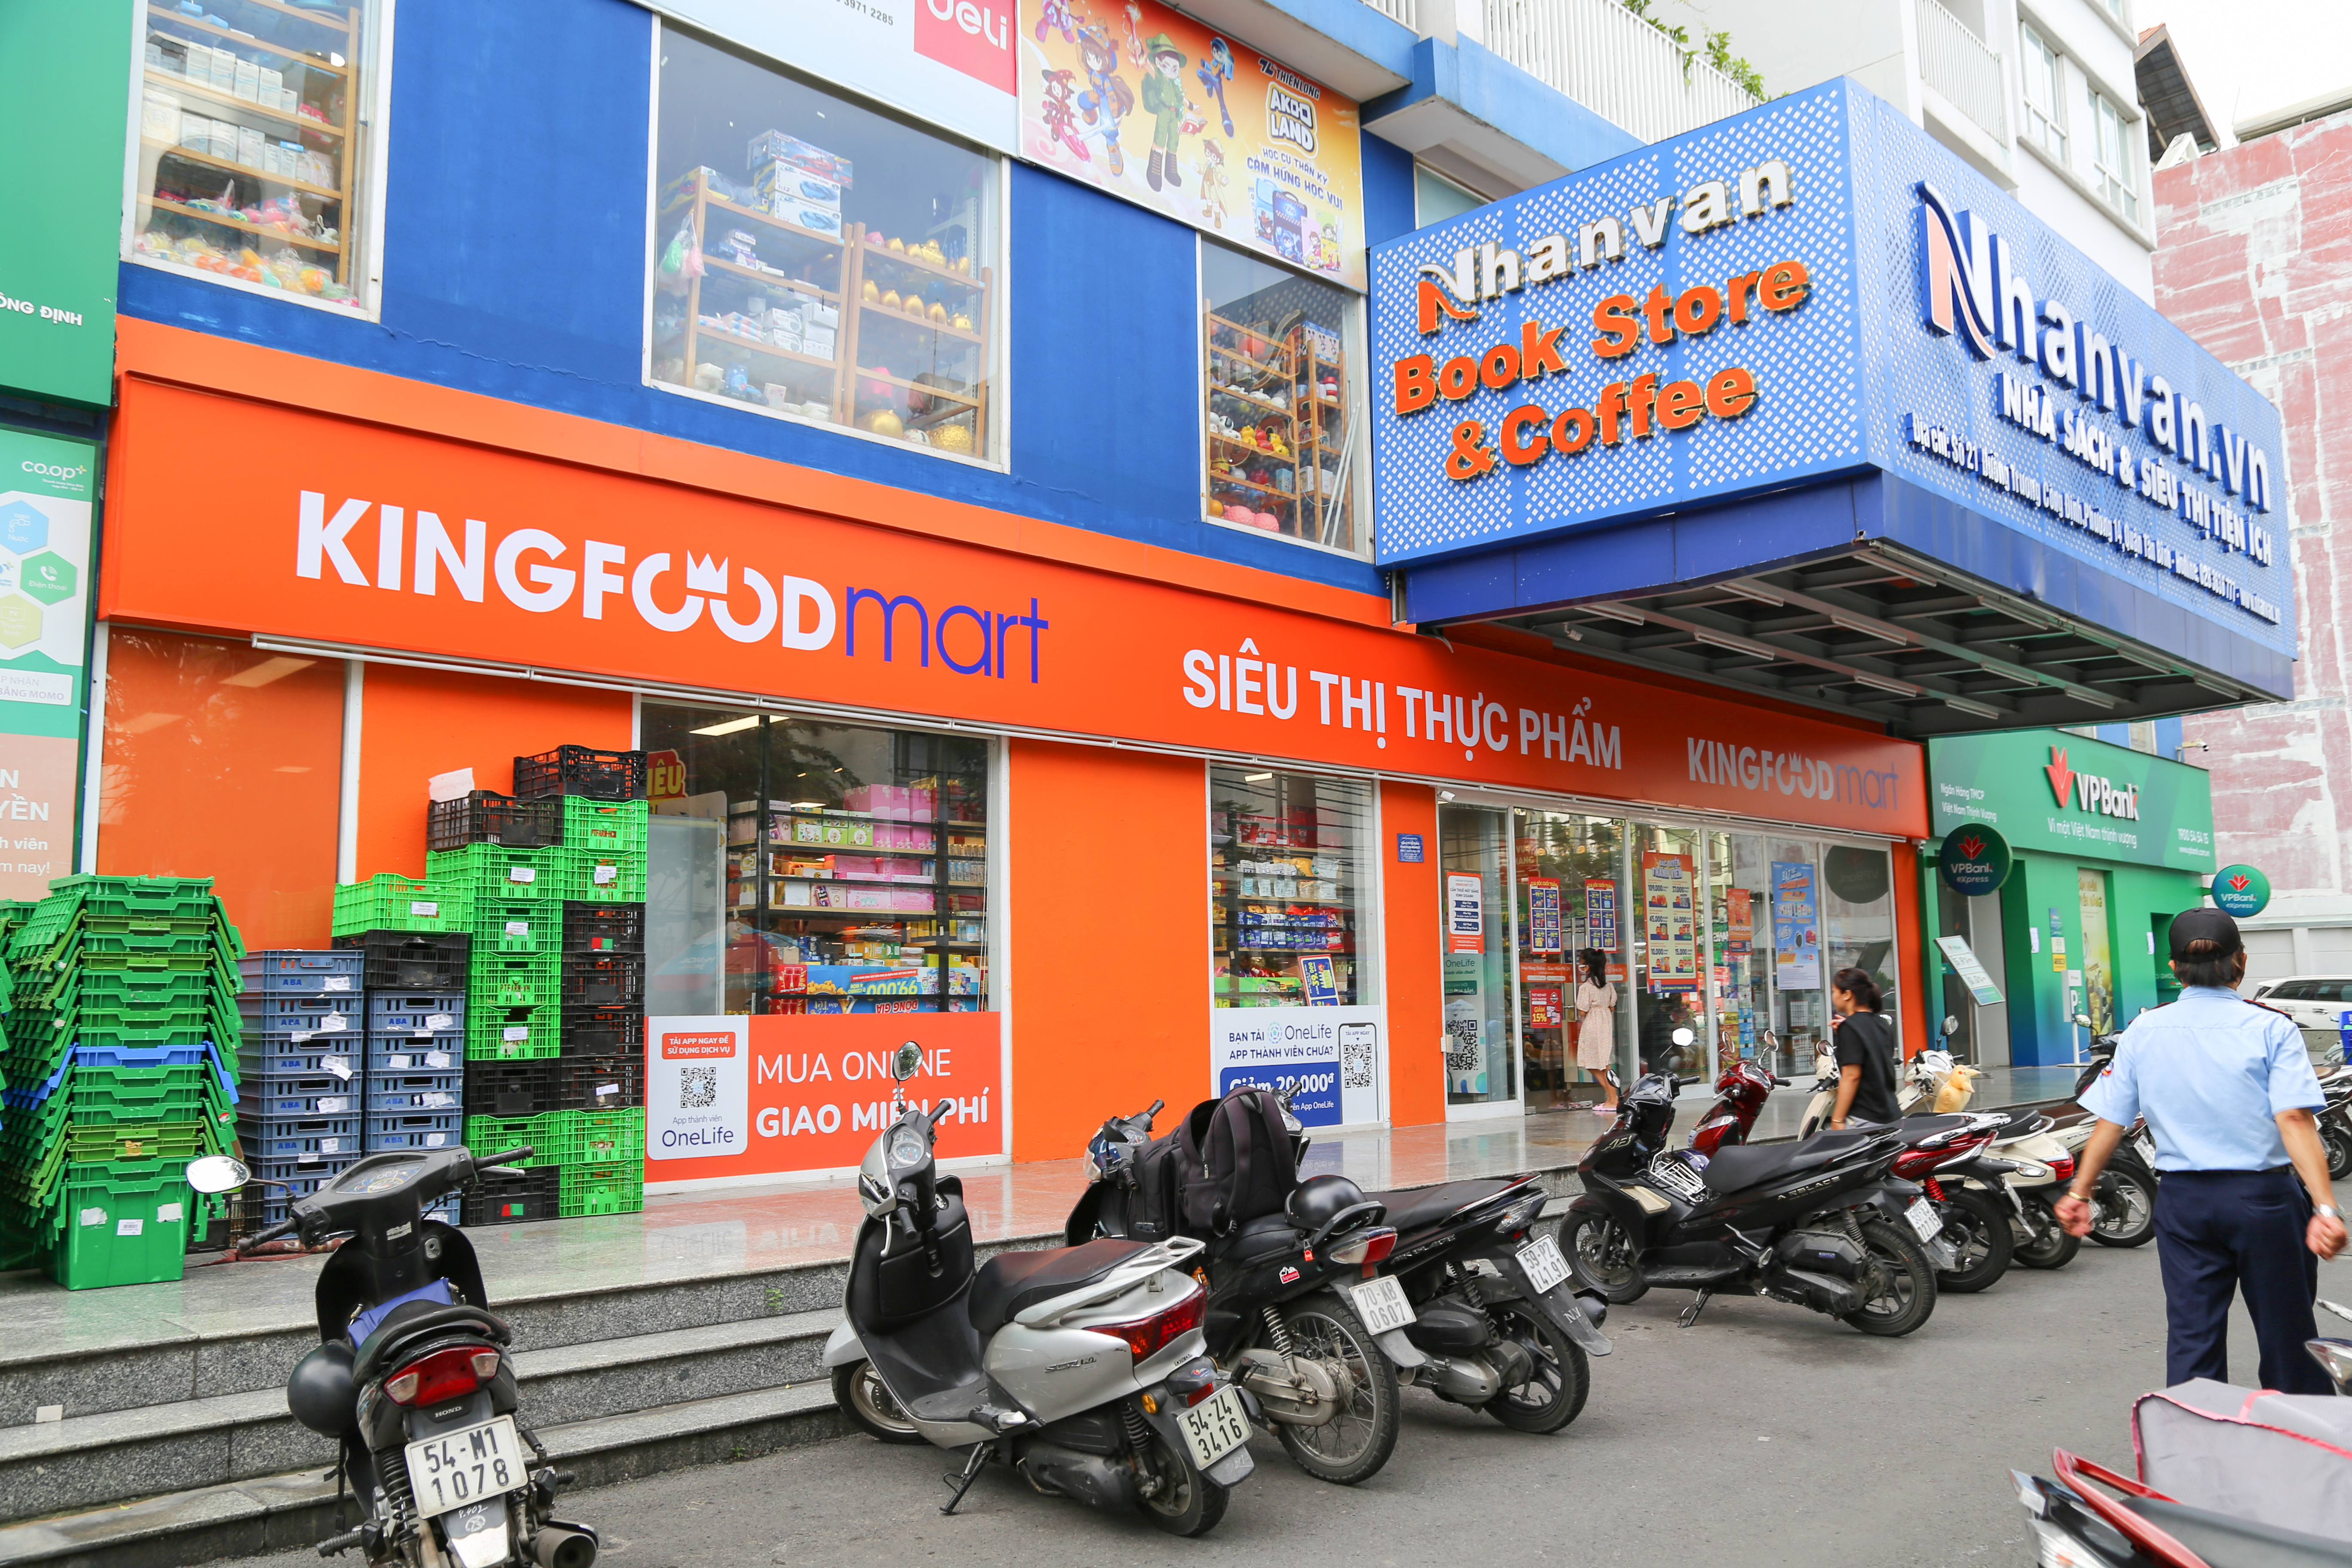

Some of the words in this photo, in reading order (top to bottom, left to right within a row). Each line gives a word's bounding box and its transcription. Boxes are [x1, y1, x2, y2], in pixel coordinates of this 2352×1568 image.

[870, 8, 893, 26] 2285
[1271, 113, 1314, 152] LAND
[1305, 180, 1324, 199] HỌC
[1326, 191, 1343, 211] VUI
[1417, 159, 1792, 335] Nhanvan
[40, 305, 83, 327] ĐỊNH
[1394, 319, 1570, 416] Book
[1591, 259, 1811, 358] Store
[2000, 372, 2057, 442] NHÀ
[2060, 408, 2114, 476] SÁCH
[2138, 457, 2179, 510] SIÊU
[2181, 481, 2211, 540] THỊ
[29, 580, 46, 588] Điện
[30, 690, 64, 701] MOMO
[1182, 638, 1297, 720] SIÊU
[1310, 670, 1386, 749] THỊ
[1396, 686, 1509, 762] THỰC
[1519, 696, 1622, 770] PHẨM
[1940, 783, 1955, 798] Ngân
[1955, 786, 1969, 800] Hàng
[1970, 787, 1985, 800] TMCP
[2076, 772, 2140, 821] VPBank
[1942, 801, 1953, 816] Việt
[1954, 803, 1966, 815] Nam
[14, 838, 48, 851] viên
[2057, 819, 2070, 841] một
[2070, 821, 2085, 841] Việt
[2086, 823, 2101, 840] Nam
[2101, 824, 2118, 845] thịnh
[2118, 829, 2138, 849] vượng
[18, 862, 50, 876] nay!
[1951, 863, 1994, 874] VPBank
[2220, 893, 2257, 902] VPBank
[1446, 959, 1475, 968] OneLife
[2070, 989, 2078, 1014] P
[1532, 1013, 1547, 1023] 15%
[669, 1036, 681, 1045] TẢI
[718, 1035, 729, 1044] ĐỂ
[1229, 1031, 1249, 1045] BẠN
[1250, 1029, 1265, 1041] TẢI
[1284, 1023, 1332, 1041] OneLife
[667, 1046, 678, 1054] SỬ
[679, 1047, 700, 1056] DỤNG
[702, 1046, 719, 1055] DỊCH
[720, 1046, 730, 1054] VỤ
[1229, 1050, 1248, 1060] APP
[1250, 1046, 1282, 1059] THÀNH
[1284, 1044, 1304, 1057] VIÊN
[1306, 1045, 1333, 1057] CHƯA?
[757, 1052, 833, 1085] MUA
[842, 1048, 951, 1082] ONLNE
[756, 1104, 842, 1138] GIAO
[939, 1086, 989, 1126] PHÍ
[1300, 1102, 1312, 1111] App
[1313, 1100, 1334, 1109] OneLife
[672, 1117, 687, 1126] App
[688, 1115, 708, 1124] thành
[662, 1126, 734, 1147] OneLife
[1522, 1241, 1555, 1269] 59-P2
[1531, 1258, 1568, 1290] 141.91
[1369, 1301, 1406, 1329] 0607
[435, 1406, 463, 1418] HOND
[1187, 1395, 1232, 1436] 54-Z4
[423, 1427, 499, 1473] 54-M1
[1198, 1418, 1242, 1461] 3416
[431, 1458, 509, 1507] 1078
